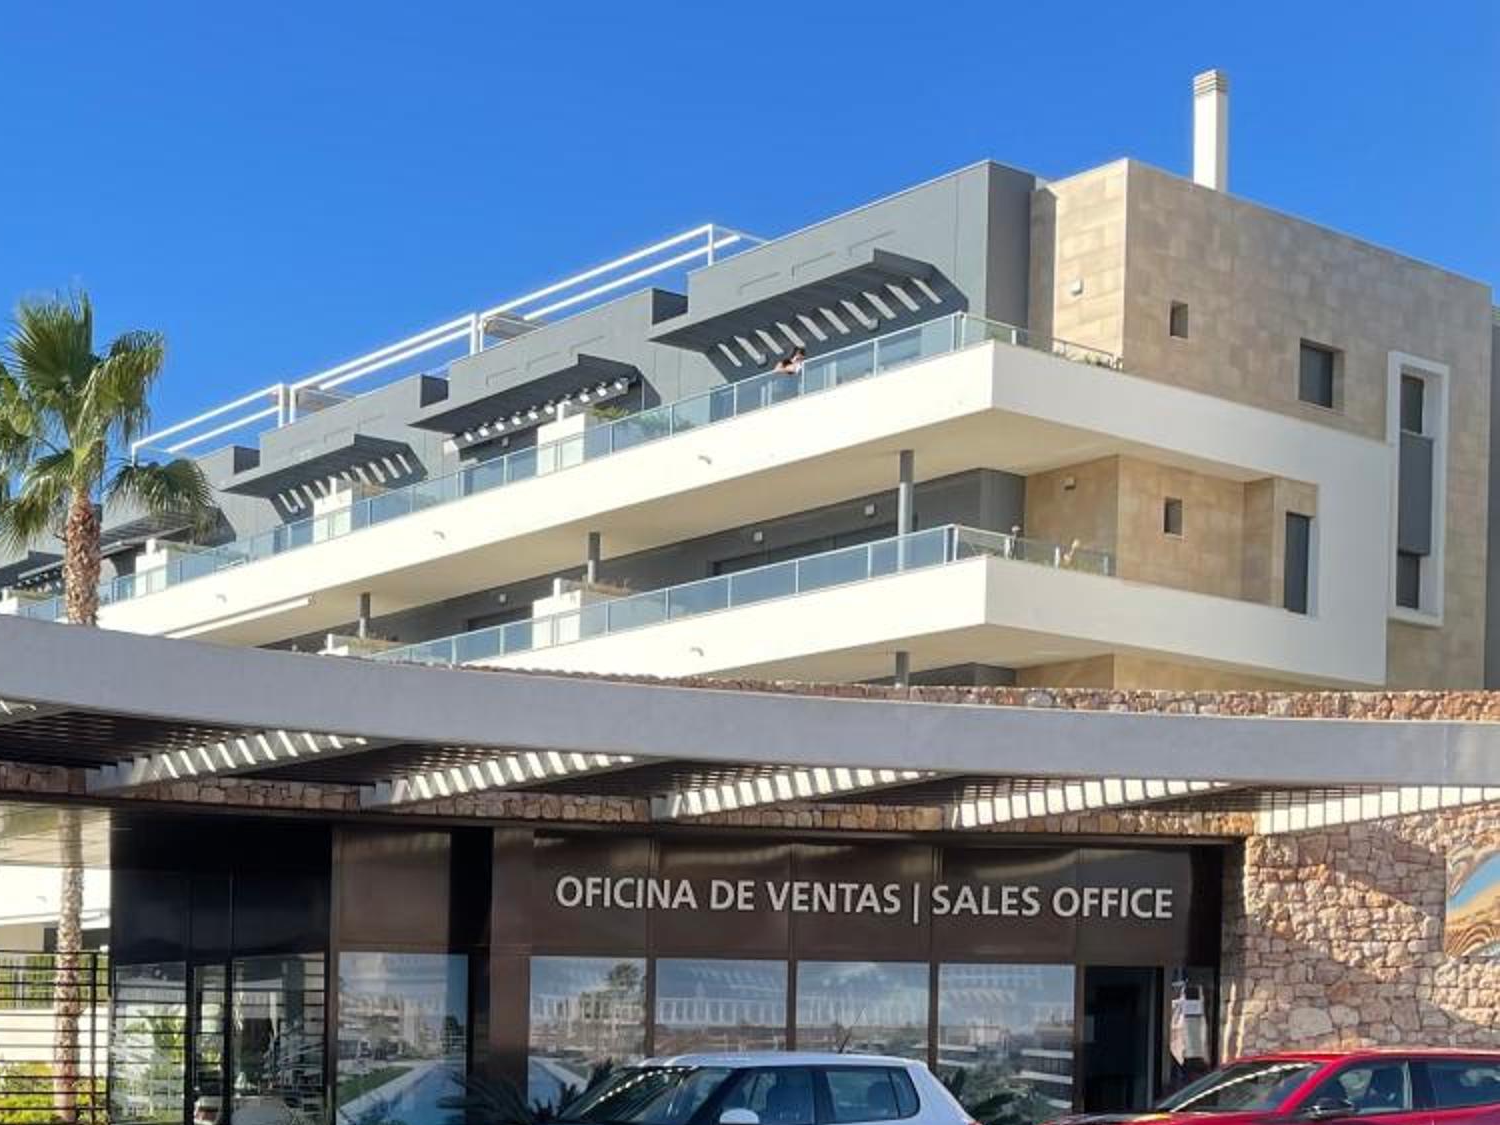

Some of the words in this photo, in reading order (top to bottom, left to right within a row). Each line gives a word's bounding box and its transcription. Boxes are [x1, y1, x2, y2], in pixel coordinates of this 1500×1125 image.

[556, 876, 698, 909] OFICINA
[710, 879, 755, 910] DE
[766, 881, 900, 914] VENTAS
[932, 885, 1041, 915] SALES
[1052, 887, 1173, 918] OFFICE
